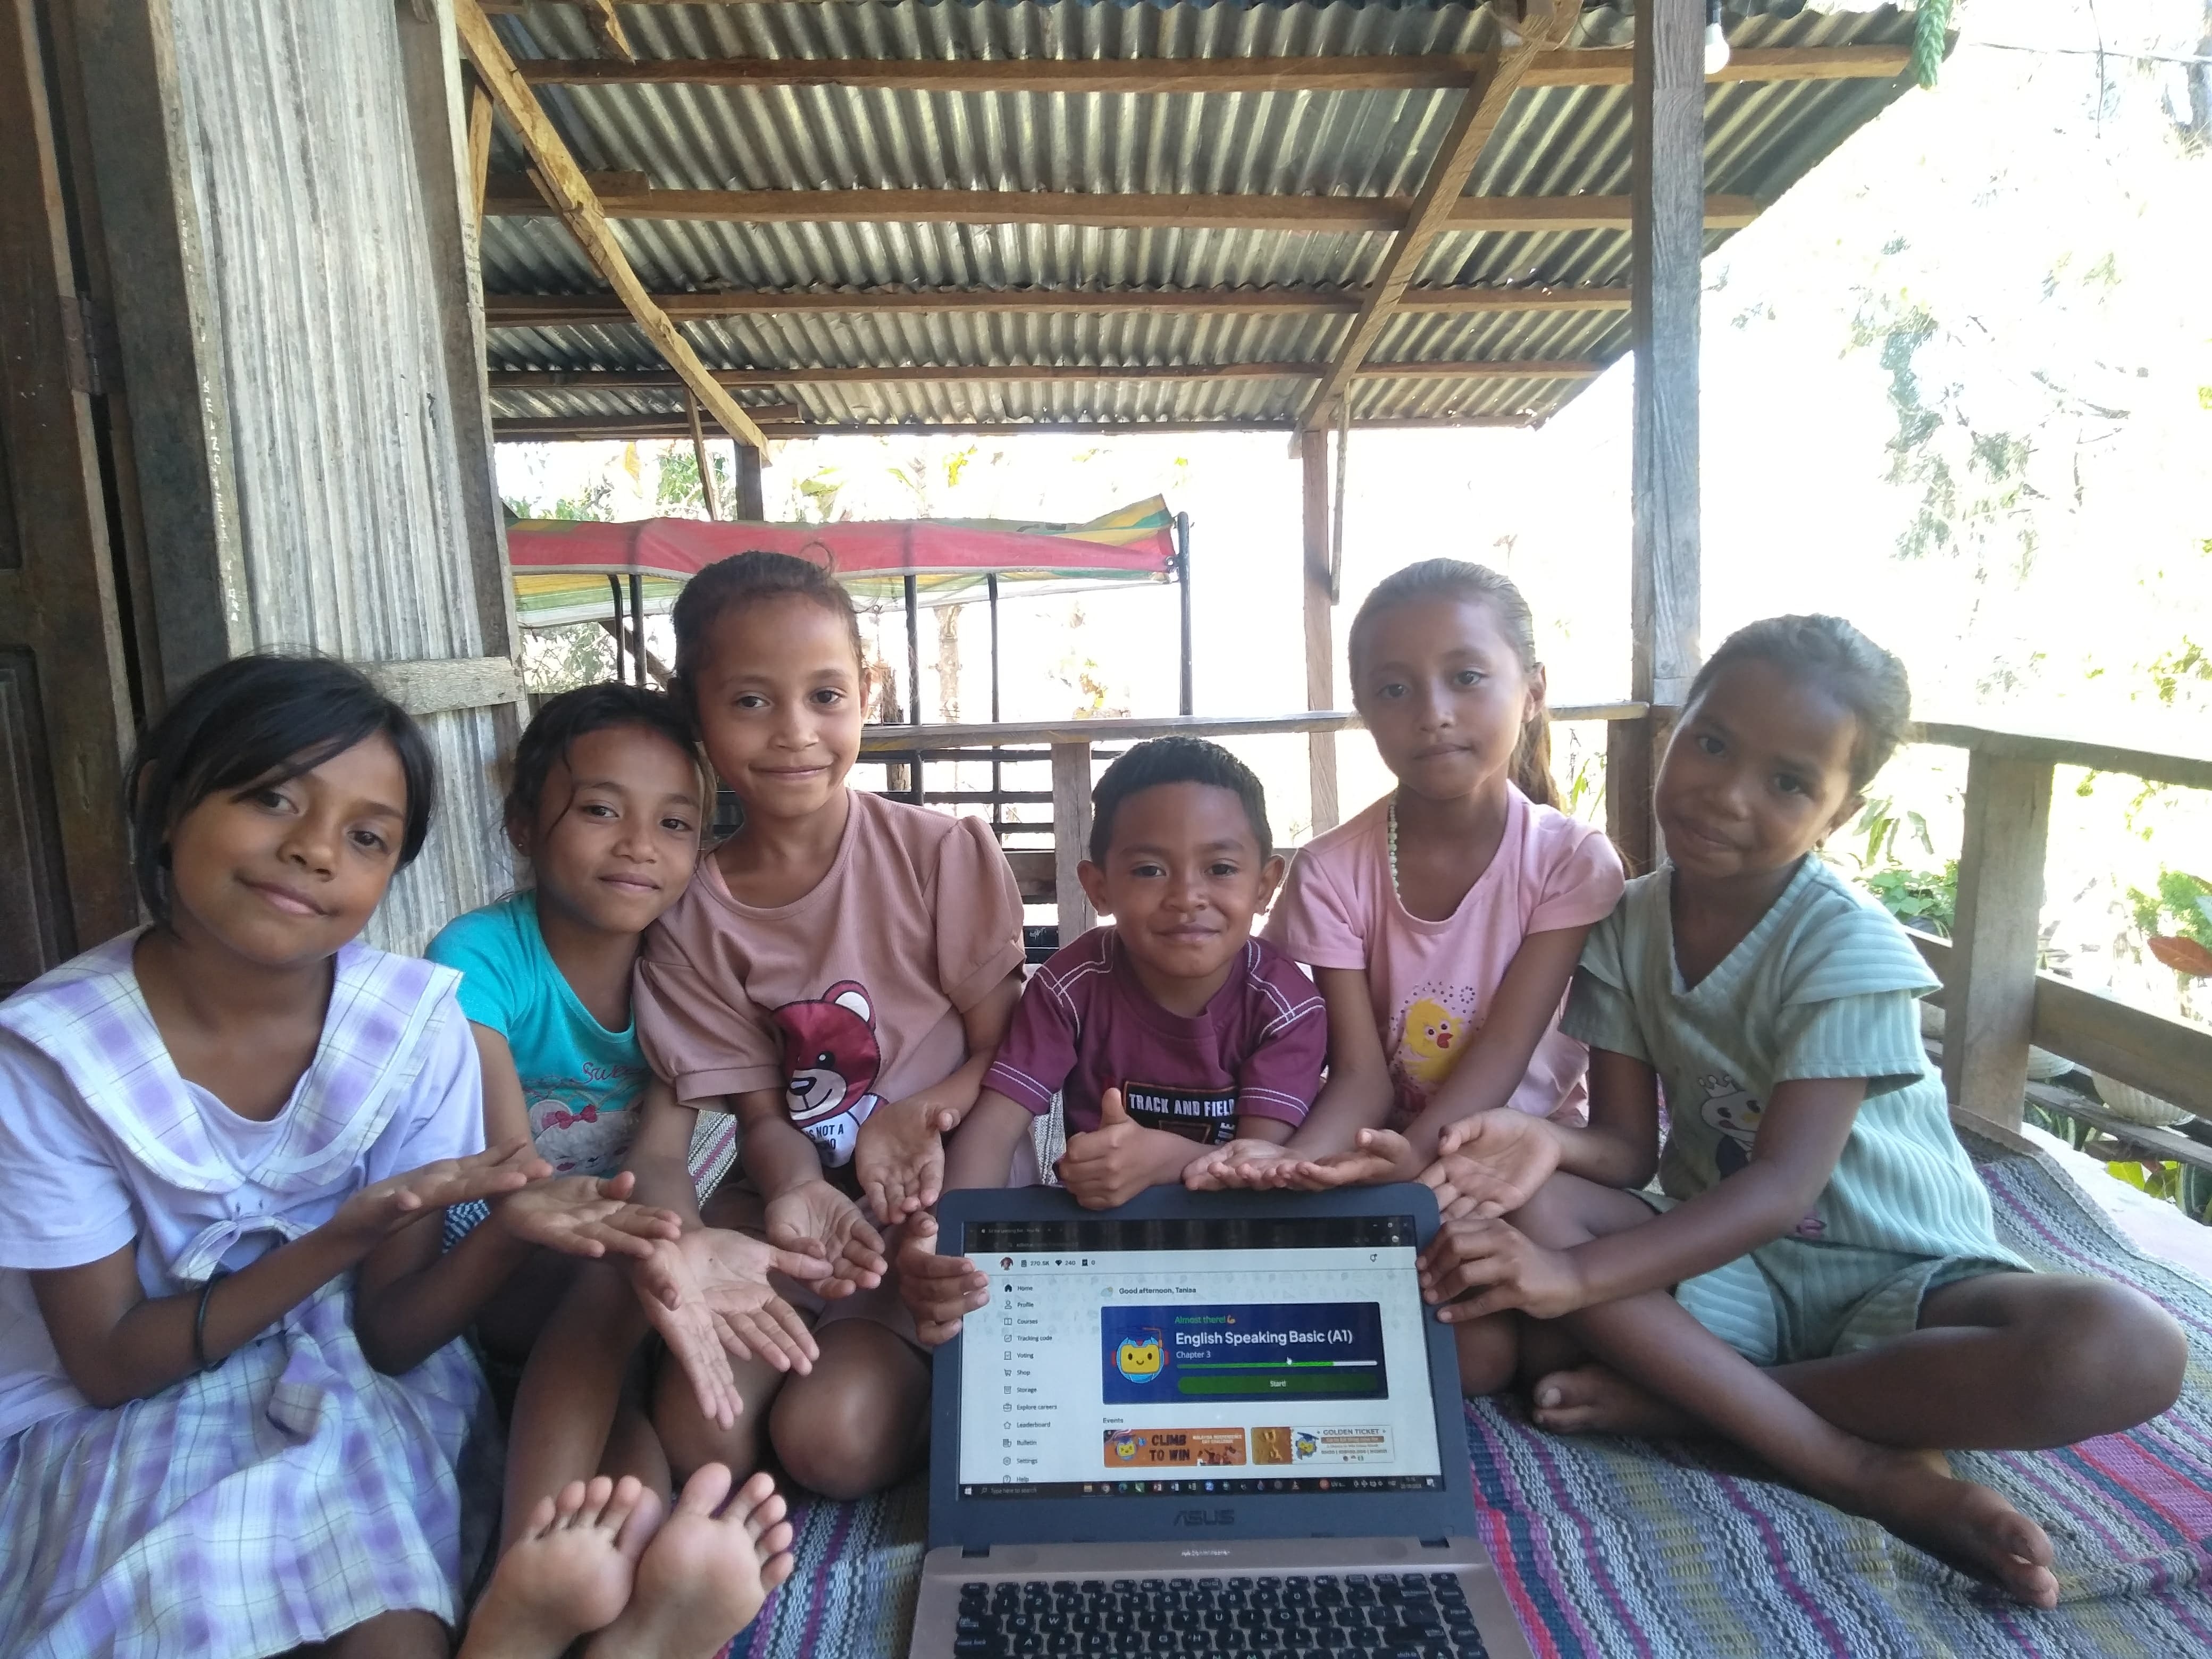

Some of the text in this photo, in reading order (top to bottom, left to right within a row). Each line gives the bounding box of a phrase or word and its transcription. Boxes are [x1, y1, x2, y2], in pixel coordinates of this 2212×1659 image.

[1128, 1093, 1169, 1113] TRACK
[1174, 1100, 1200, 1117] AND
[816, 1125, 835, 1138] NOT
[837, 1124, 844, 1135] A
[1176, 1329, 1353, 1348] English Speaking Basic (A1)
[1176, 1351, 1204, 1360] Chapter
[1151, 1434, 1187, 1446] CLIMB
[1149, 1449, 1190, 1461] TO WIN
[1172, 1509, 1235, 1527] ASUS
[1193, 1633, 1201, 1642] H
[1261, 1632, 1268, 1640] K
